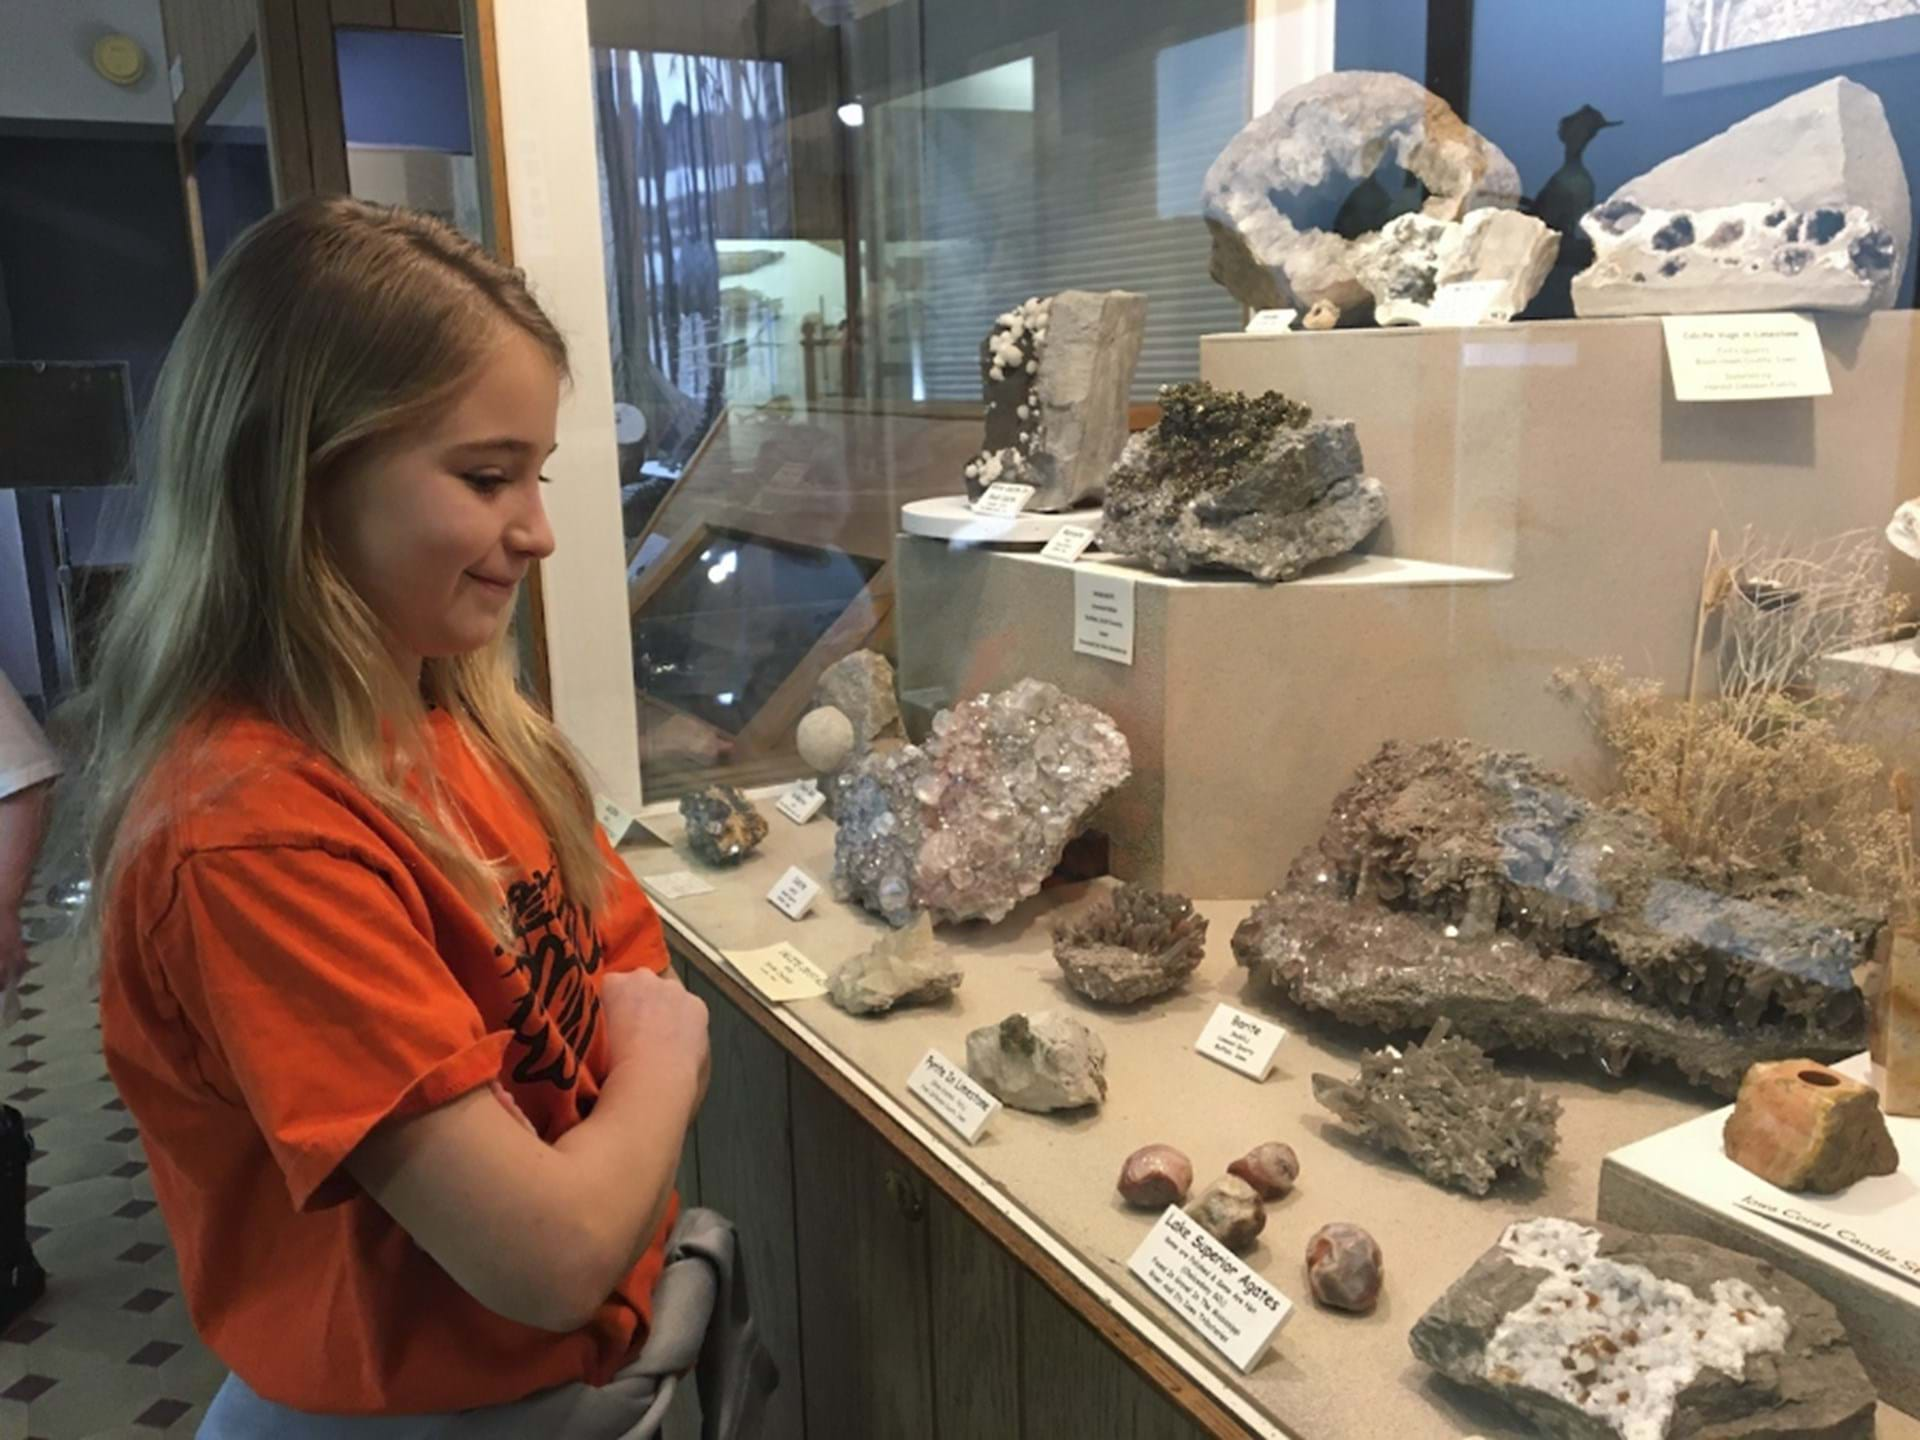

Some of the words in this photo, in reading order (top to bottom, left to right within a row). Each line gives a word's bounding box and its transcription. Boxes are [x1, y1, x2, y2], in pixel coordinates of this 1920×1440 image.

[1232, 1015, 1261, 1036] Barite
[927, 1055, 946, 1077] Pyrite
[954, 1079, 989, 1111] Limestone
[1742, 1195, 1778, 1212] Iowa
[1782, 1209, 1832, 1230] Coral
[1837, 1229, 1897, 1262] Candle
[1164, 1214, 1191, 1240] Lake
[1191, 1235, 1238, 1273] Superior
[1238, 1275, 1280, 1311] Agates
